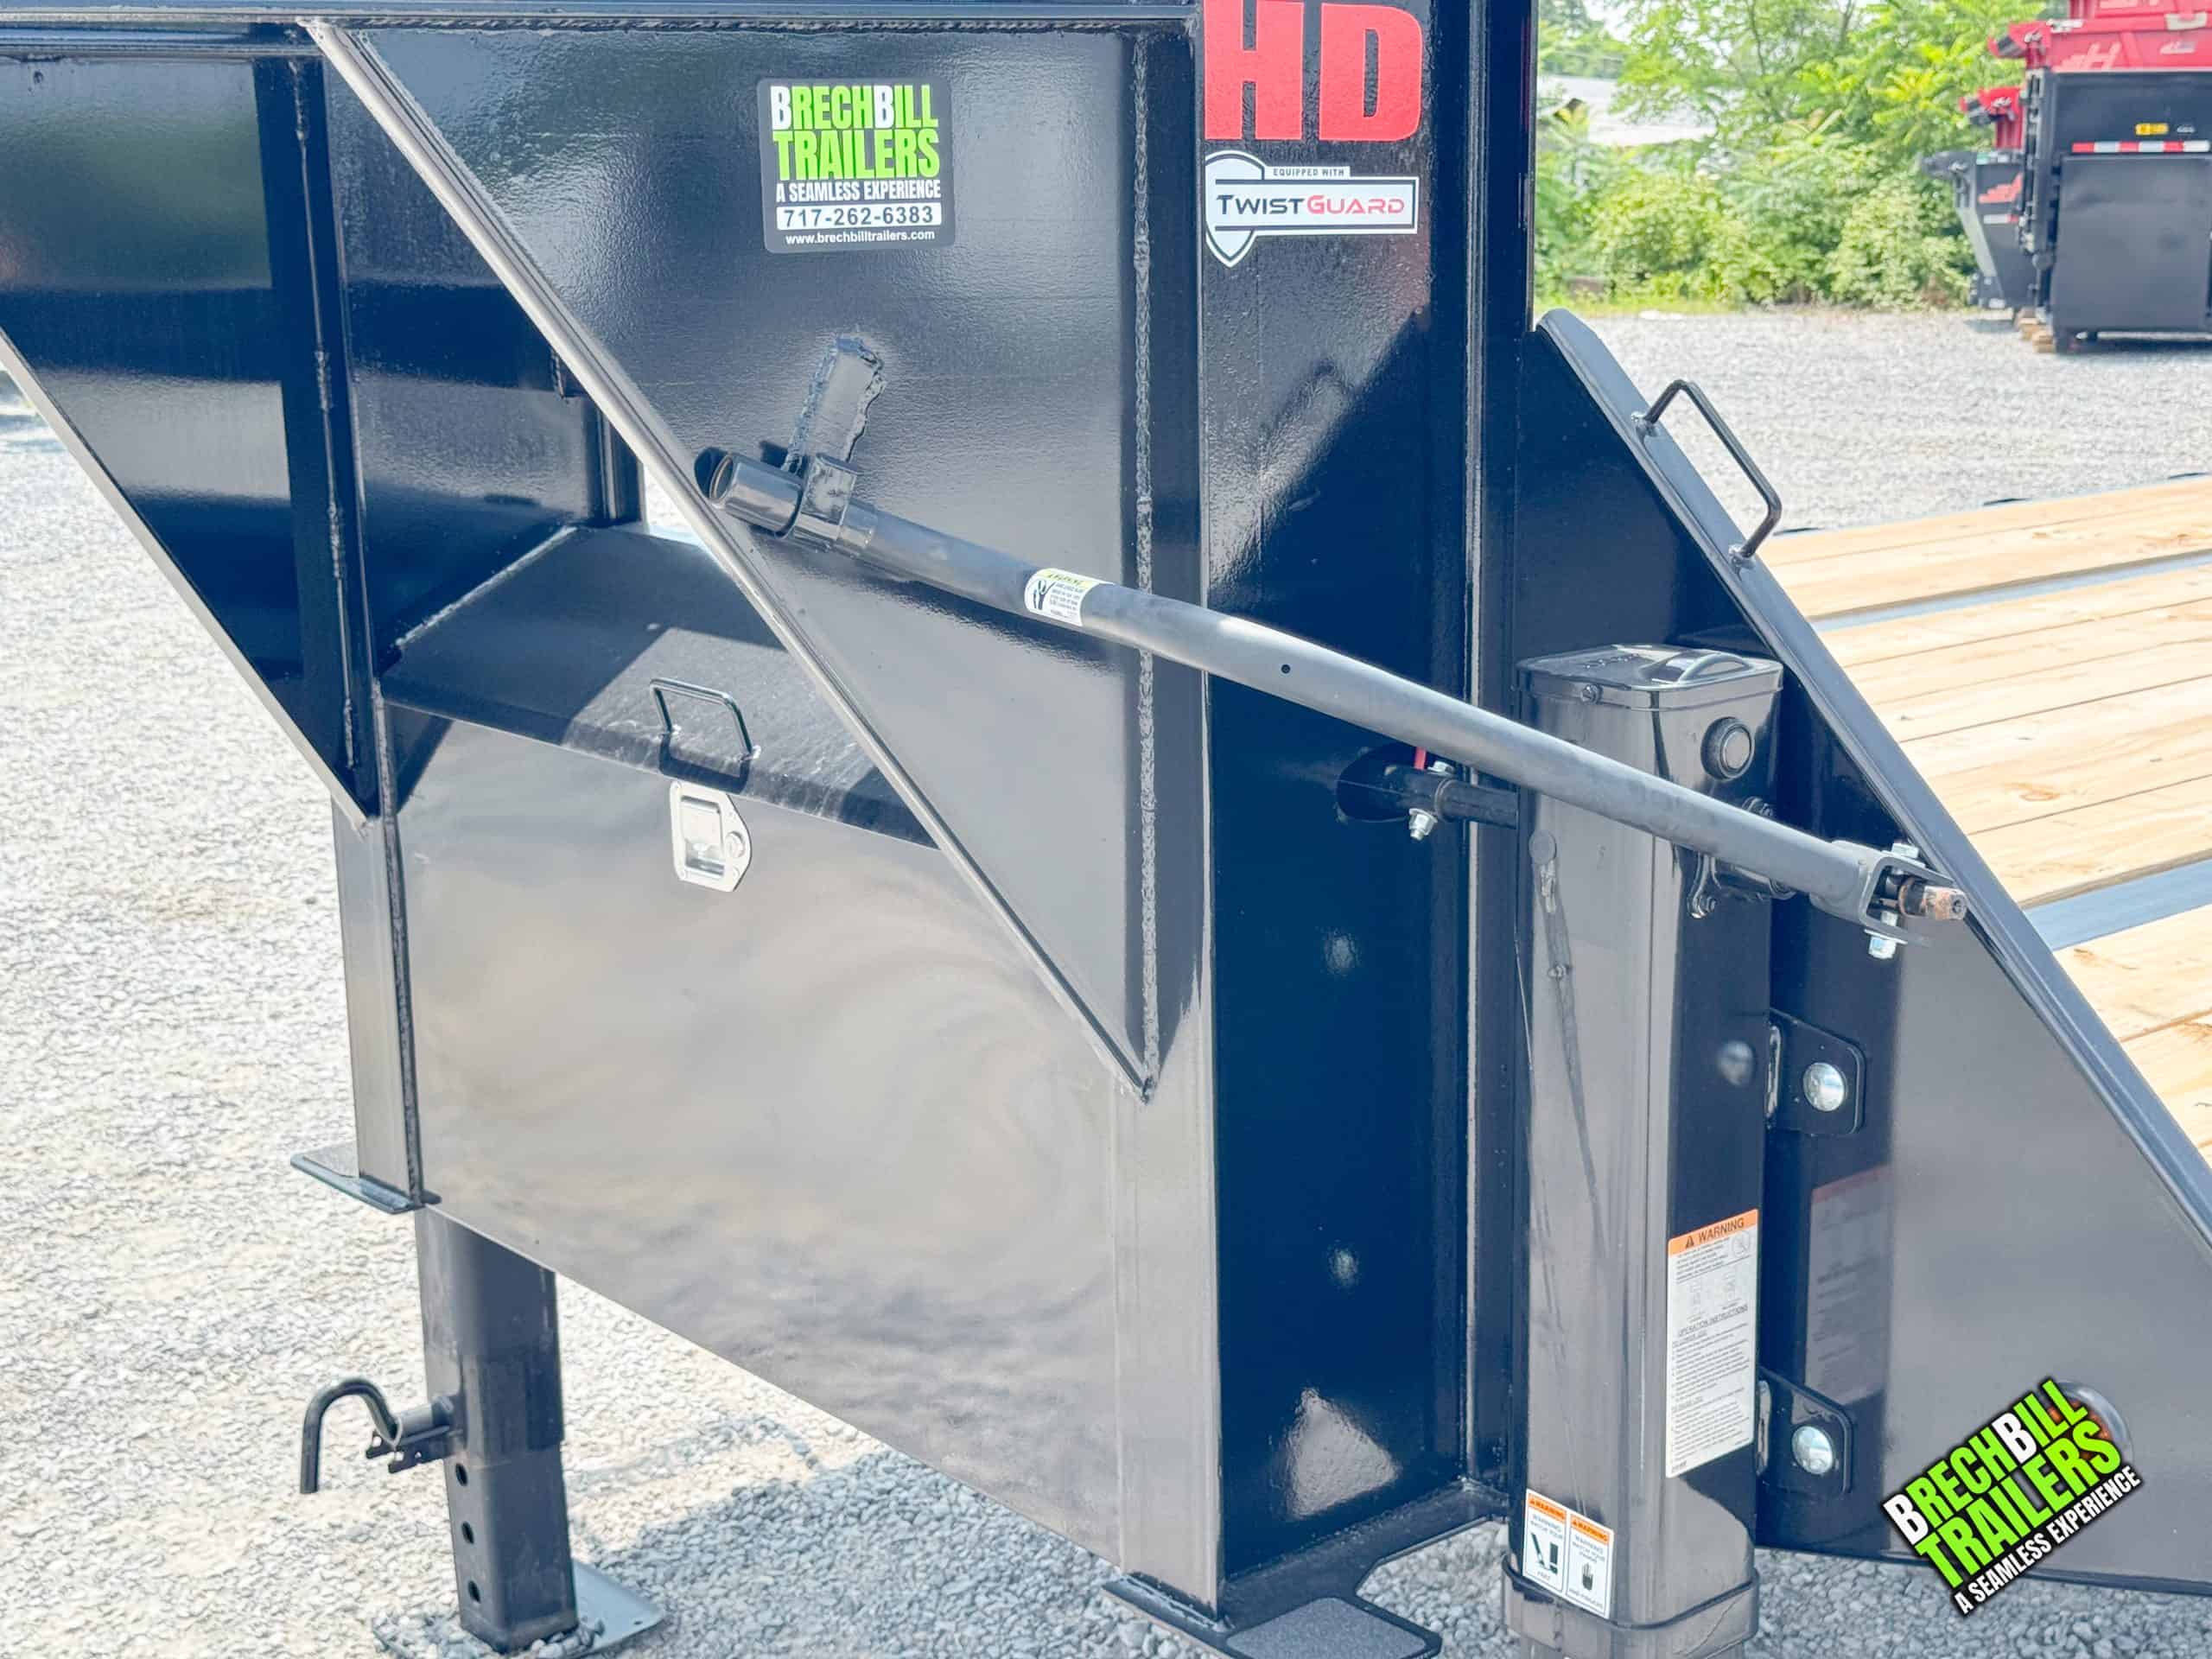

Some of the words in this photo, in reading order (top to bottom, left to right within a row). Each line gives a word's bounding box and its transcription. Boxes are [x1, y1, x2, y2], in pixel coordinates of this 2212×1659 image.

[1204, 0, 1423, 142] HD
[770, 84, 939, 130] BRECHBILL
[772, 128, 941, 181] TRAILERS
[1273, 168, 1319, 176] EQUIPPED
[1321, 168, 1345, 176] WITH
[776, 182, 785, 203] A
[789, 181, 861, 202] SEAMLESS
[863, 179, 942, 200] EXPERIENCE
[783, 206, 934, 227] 717-262-6383
[785, 230, 936, 245] www.brechbilltrailers.com
[1698, 1217, 1745, 1244] WARNING
